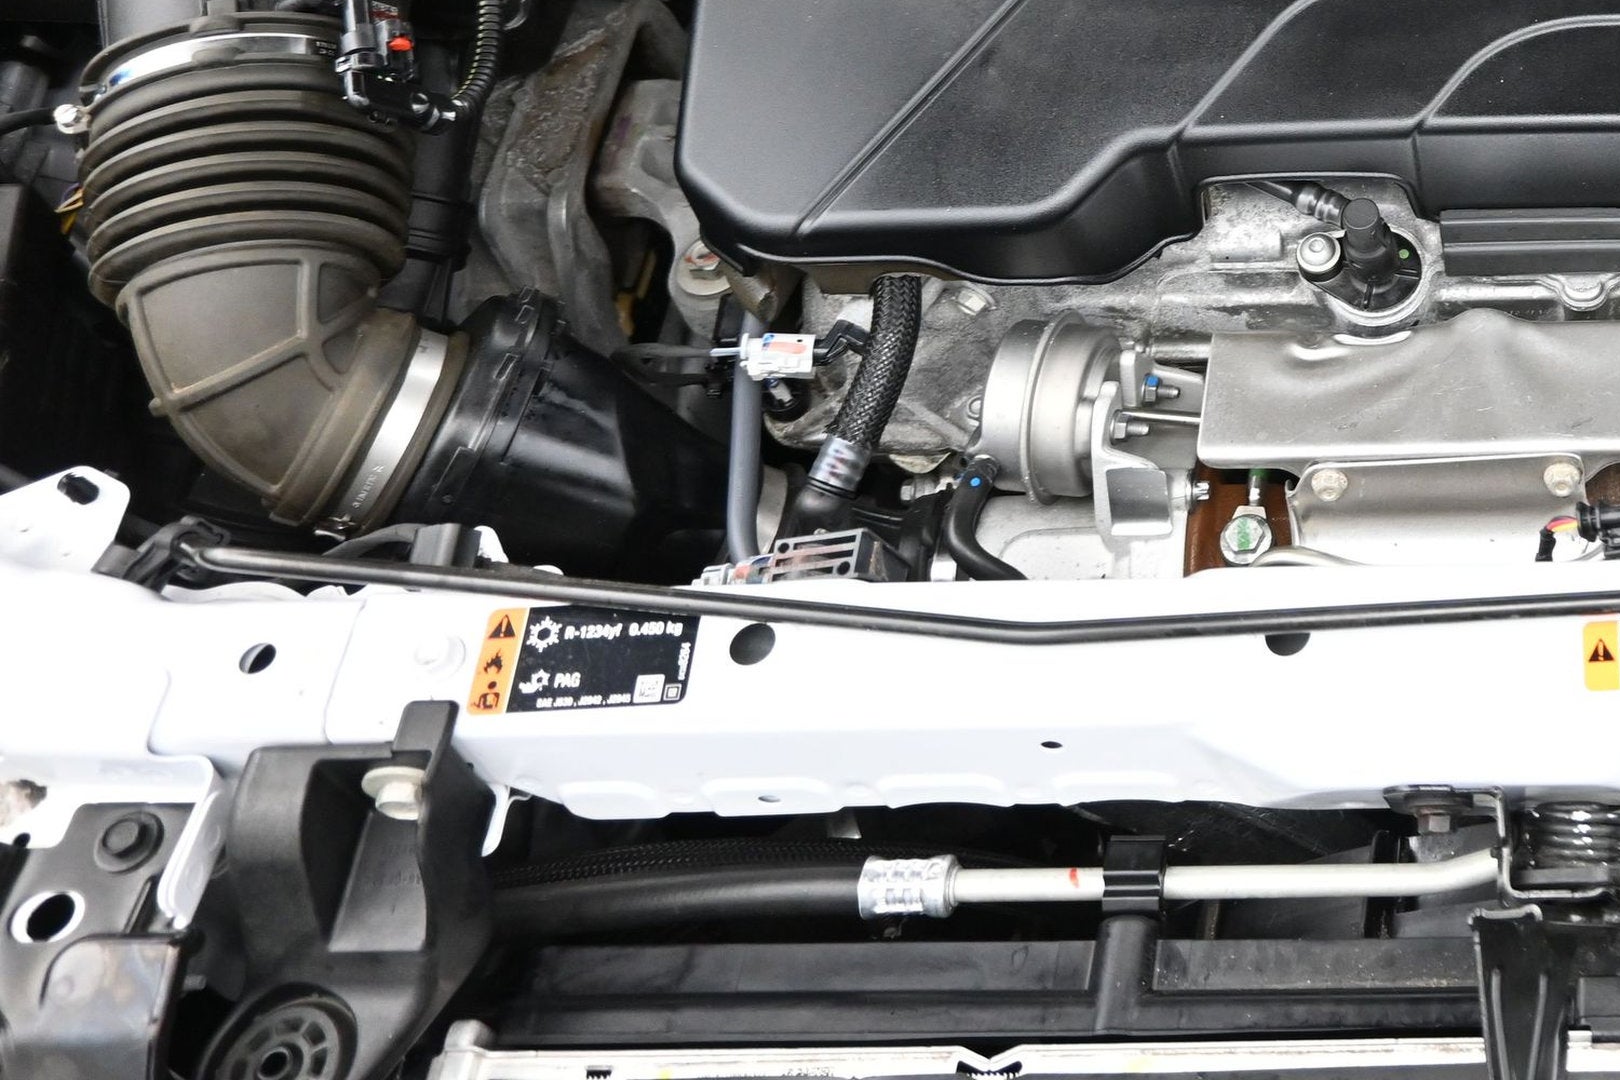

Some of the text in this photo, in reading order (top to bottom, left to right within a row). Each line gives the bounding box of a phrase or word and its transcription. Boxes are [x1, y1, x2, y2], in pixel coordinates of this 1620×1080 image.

[564, 621, 683, 640] R-1234yf 0.450 kg
[553, 672, 581, 688] PAG
